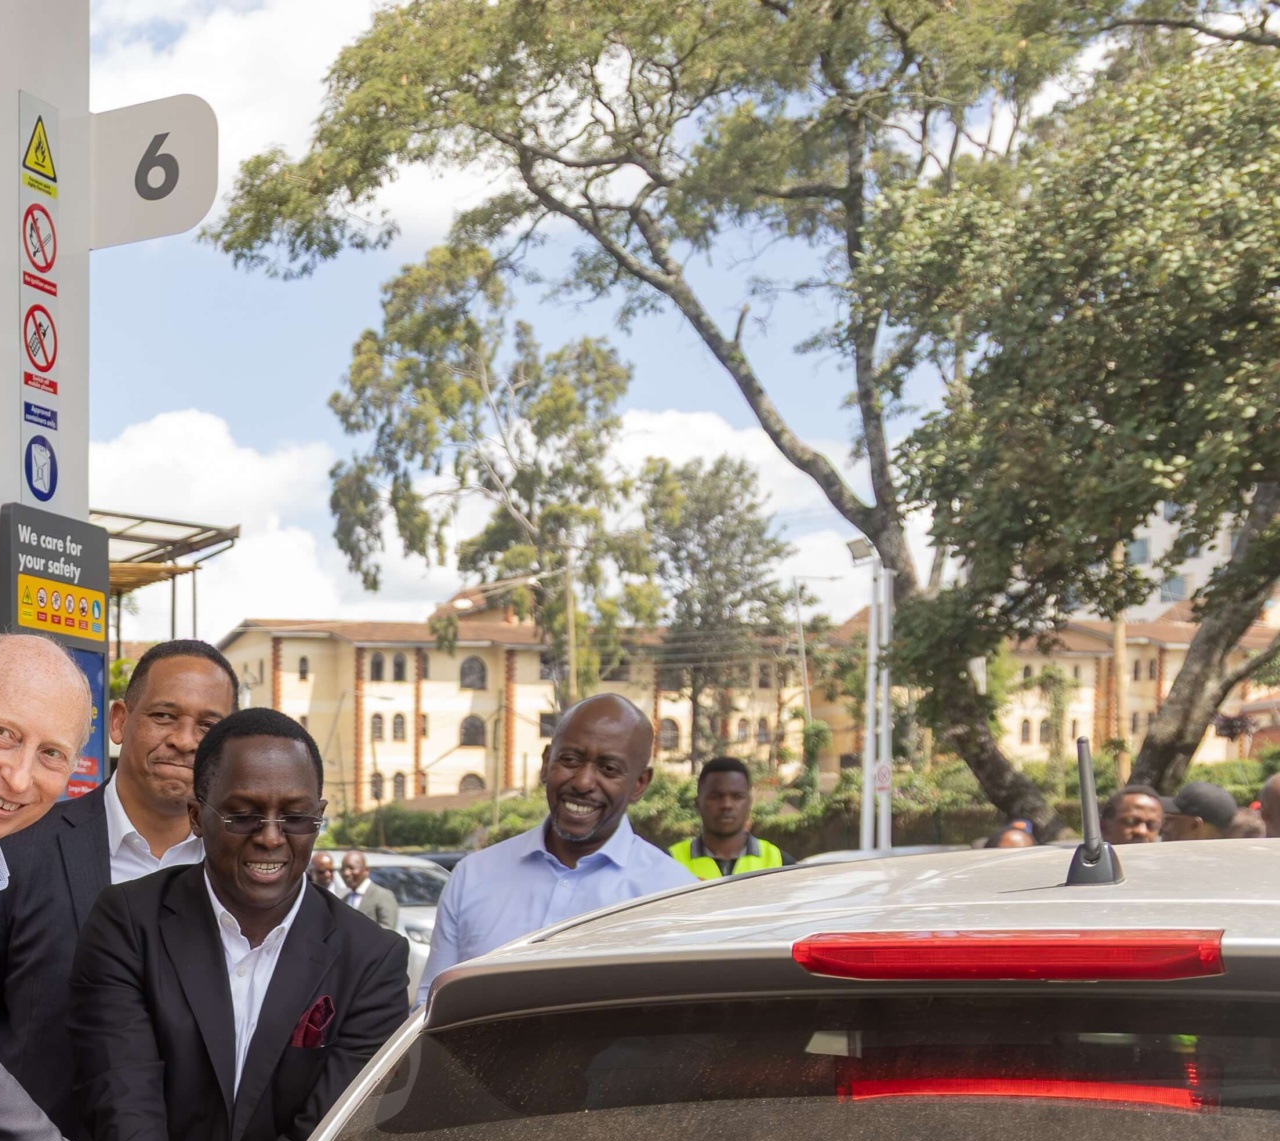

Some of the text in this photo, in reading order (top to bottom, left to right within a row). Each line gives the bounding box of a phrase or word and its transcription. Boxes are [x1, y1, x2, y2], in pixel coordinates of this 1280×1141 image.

[134, 131, 179, 201] 6
[18, 524, 83, 557] We care for
[18, 552, 81, 584] your safety
